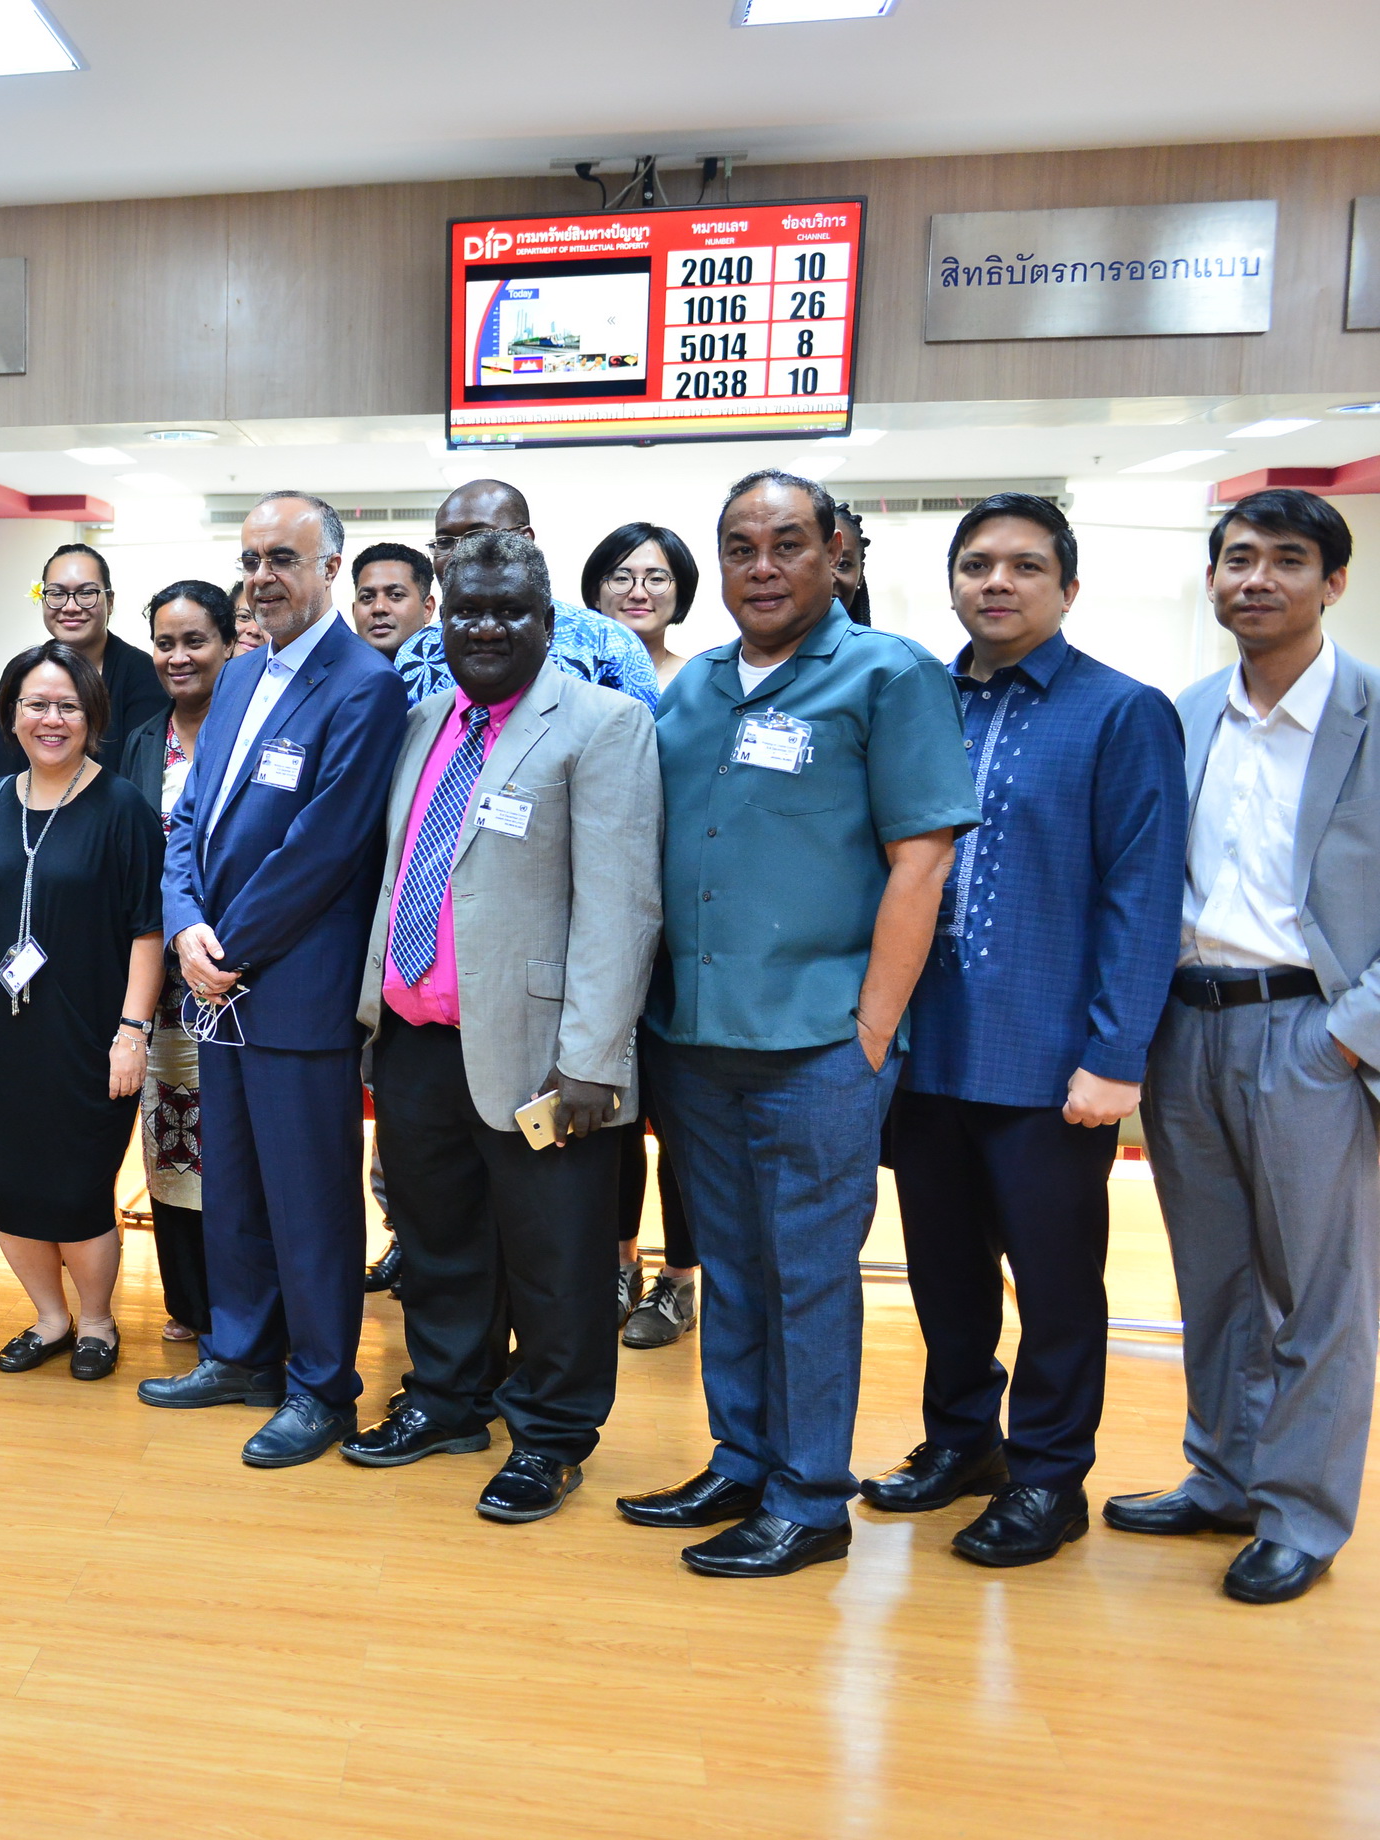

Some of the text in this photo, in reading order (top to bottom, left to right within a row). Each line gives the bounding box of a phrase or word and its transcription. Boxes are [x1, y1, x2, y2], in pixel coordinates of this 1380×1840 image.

[691, 220, 749, 235] หมายเลข
[781, 212, 847, 231] ช่องบริการ
[516, 223, 650, 244] กรมทรัพย์สินทางปัญญา
[704, 237, 735, 246] NUMBER
[796, 232, 831, 241] CHANNEL
[516, 241, 650, 256] DEPARTMENT OF INTELLECTUAL PROPERTY
[681, 252, 826, 287] 2040 10
[940, 251, 1261, 289] สิทธิบัตรการออกแบบ
[508, 288, 534, 299] Today
[683, 290, 826, 325] 1016 26
[680, 329, 814, 363] 5014 8
[675, 366, 819, 400] 2038 10
